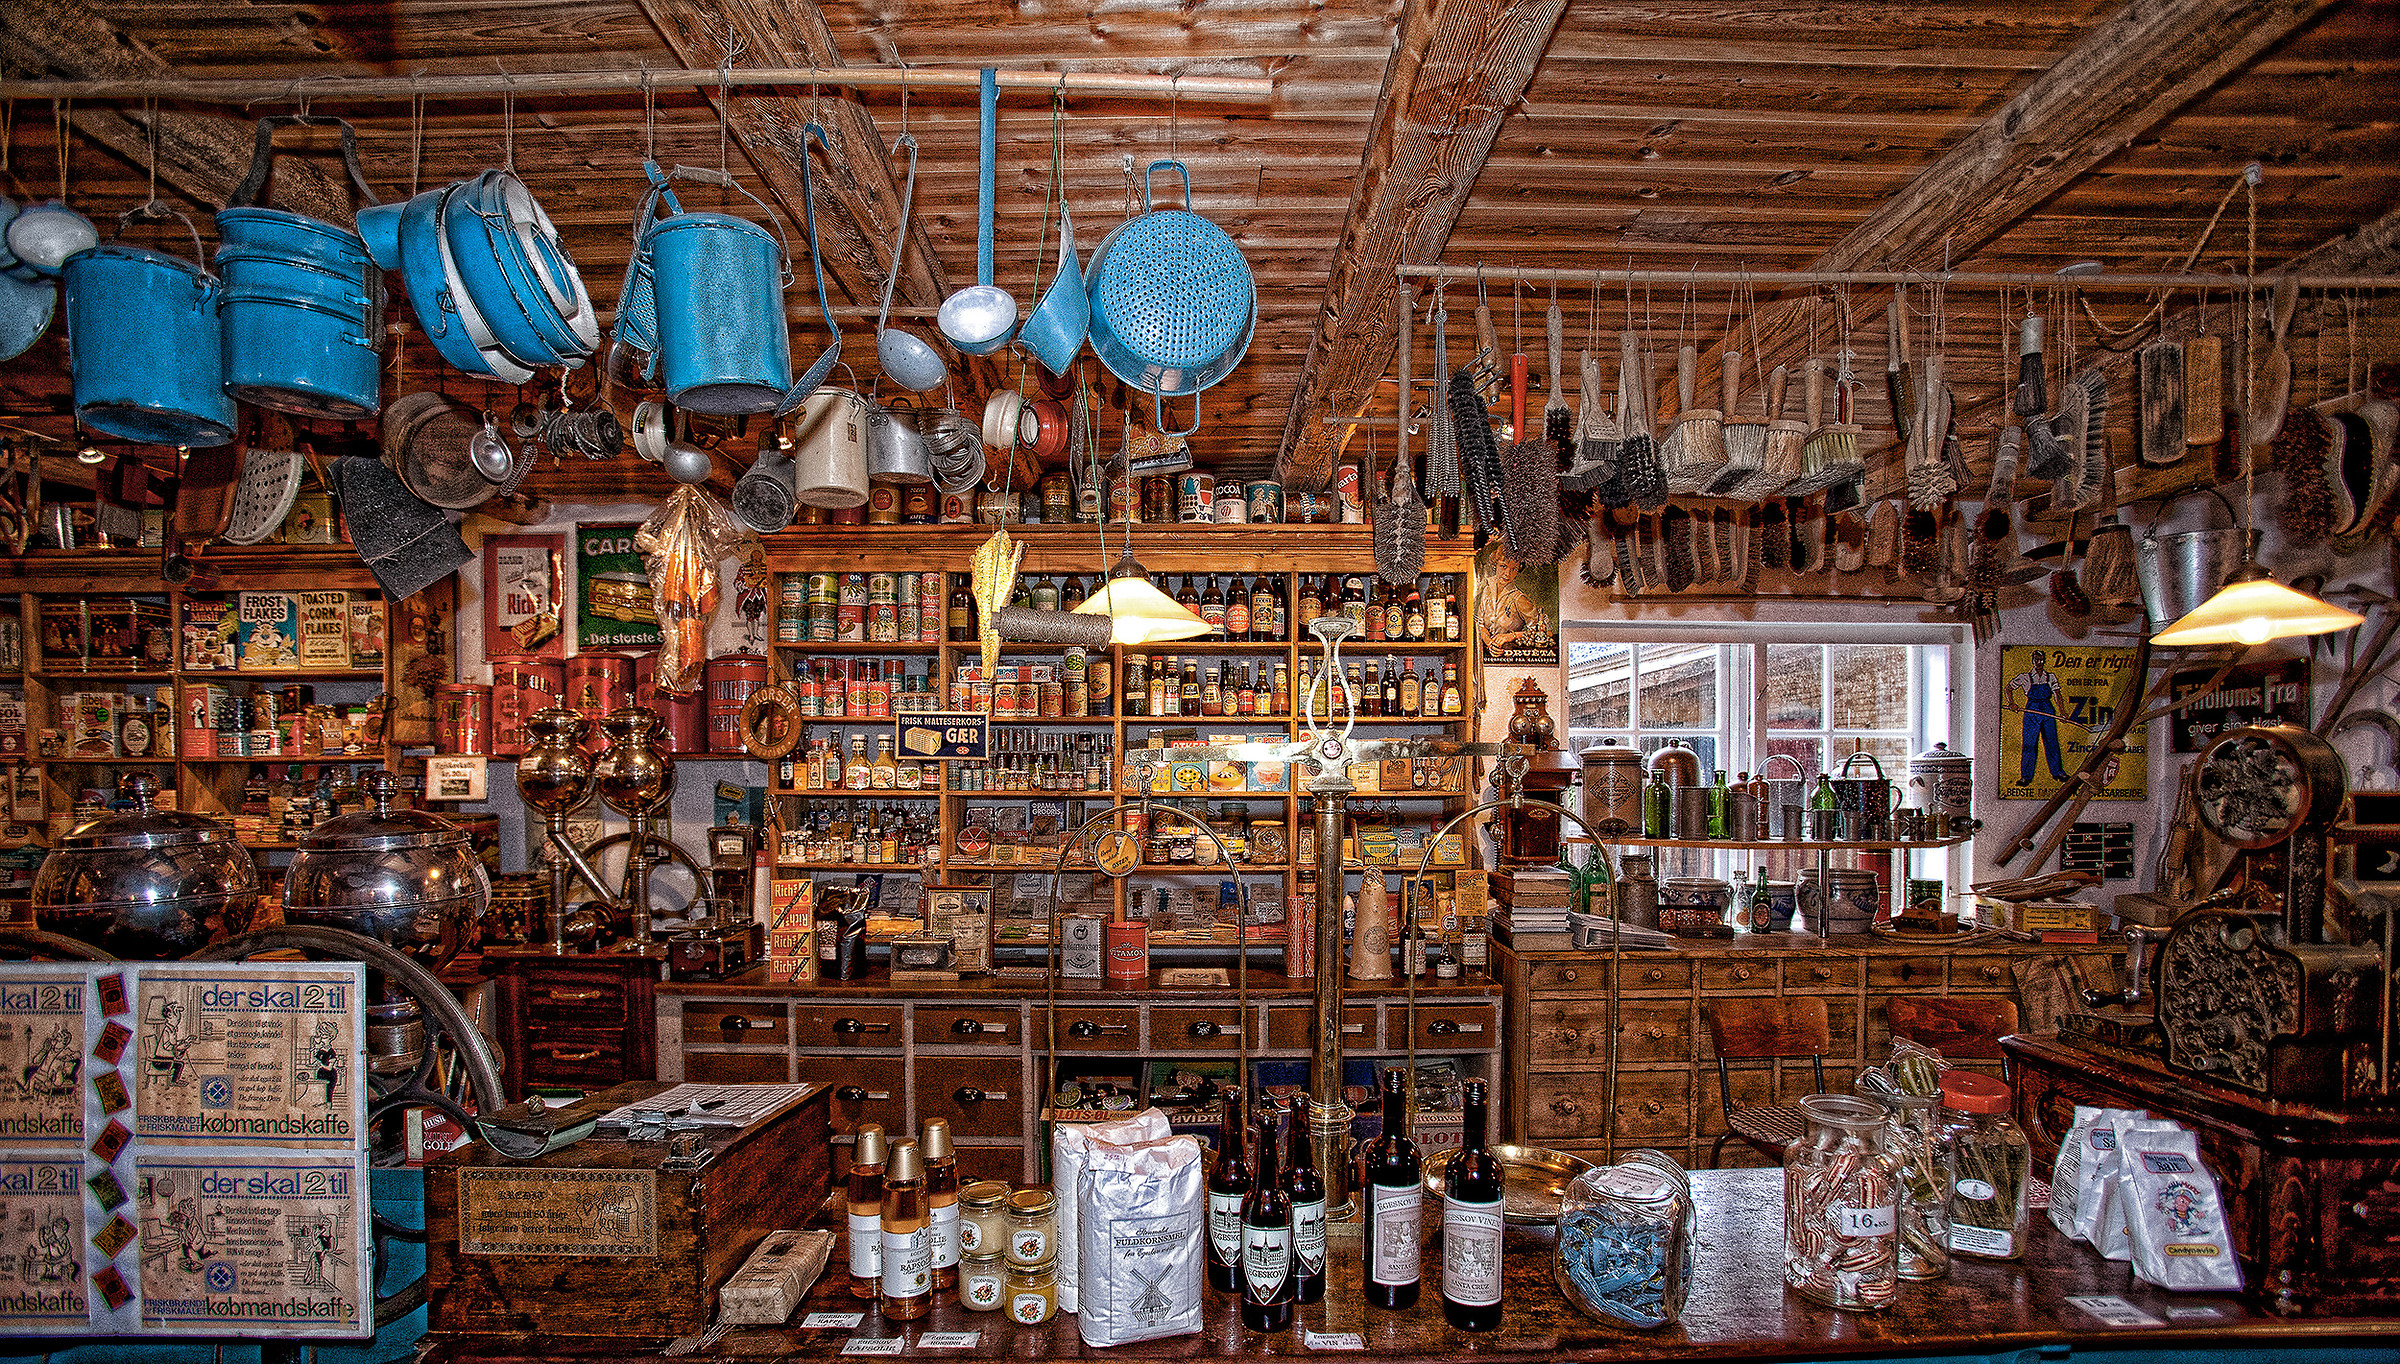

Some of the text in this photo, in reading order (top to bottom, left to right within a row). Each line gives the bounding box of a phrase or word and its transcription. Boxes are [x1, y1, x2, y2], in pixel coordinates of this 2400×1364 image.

[245, 595, 283, 608] FROST
[300, 592, 345, 604] TOASTED
[243, 607, 285, 620] FLAKES
[308, 607, 336, 620] CORN
[304, 622, 342, 635] FLAKES
[2052, 651, 2082, 669] Den
[2085, 657, 2100, 669] er
[900, 717, 985, 726] FRISK MALTESERKORS-
[2188, 721, 2219, 737] giver
[945, 727, 979, 744] GÆR
[40, 986, 61, 1009] 2
[63, 986, 82, 1010] til
[203, 985, 346, 1009] der skal 2 til
[201, 1112, 350, 1136] købmandskaffe
[37, 1168, 58, 1191] 2
[60, 1168, 79, 1192] til
[202, 1172, 348, 1196] der skal 2 til
[1115, 1231, 1186, 1246] FULDKORNSMEL
[206, 1297, 356, 1319] købmandskaffe
